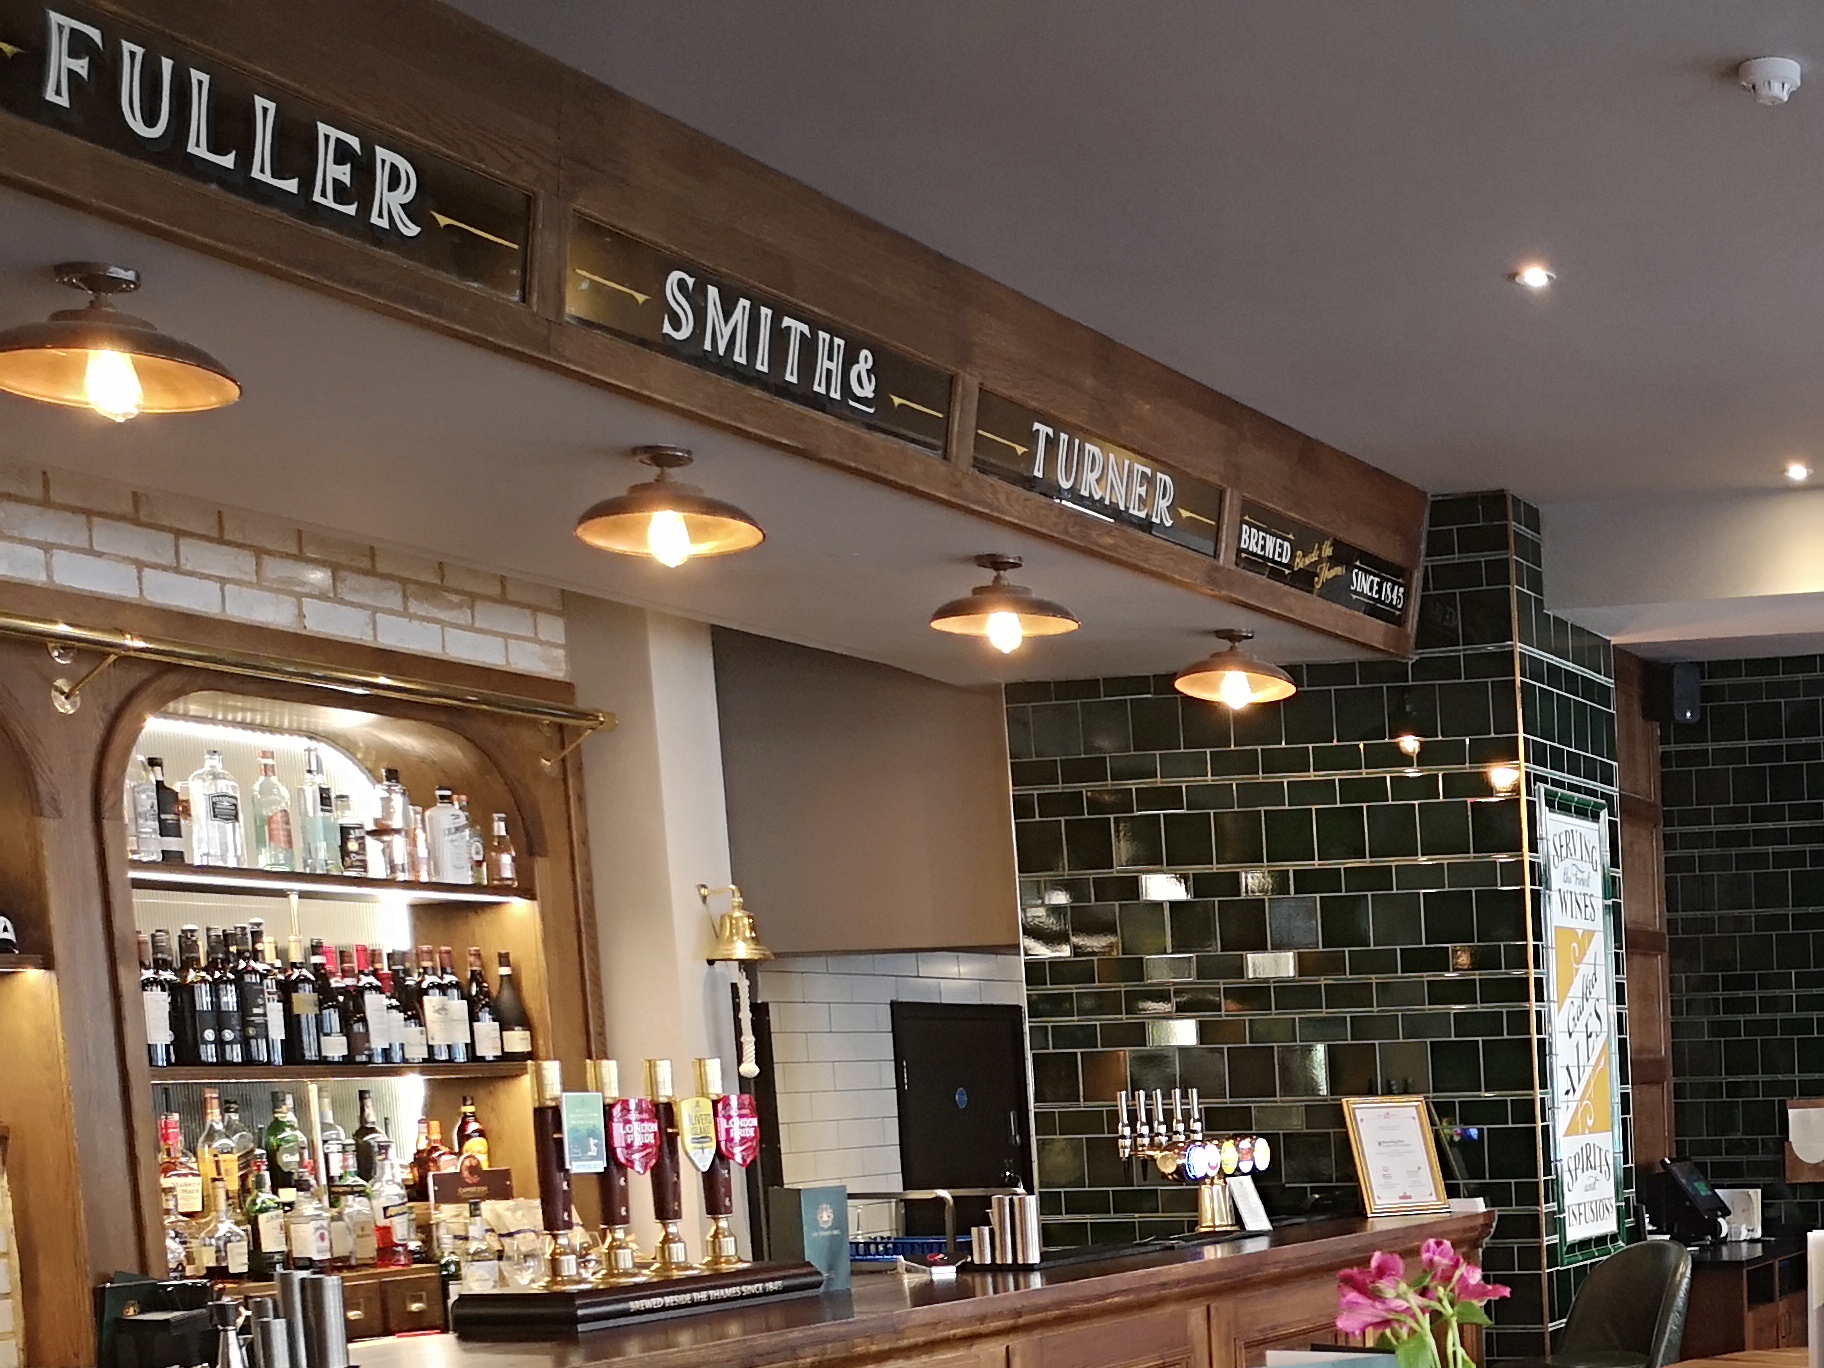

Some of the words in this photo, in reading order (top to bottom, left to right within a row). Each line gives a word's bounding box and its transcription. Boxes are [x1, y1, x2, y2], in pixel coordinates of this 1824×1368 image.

[44, 9, 422, 237] FULLER
[1032, 422, 1174, 527] TURNER
[1240, 524, 1292, 564] BREWED
[1321, 540, 1334, 558] the
[1350, 569, 1381, 599] SINCE
[1381, 580, 1405, 609] 1845
[1552, 829, 1598, 872] SERVING
[1557, 888, 1596, 922] WINES
[1564, 998, 1603, 1113] ALES
[620, 1120, 658, 1134] LONDON
[627, 1132, 655, 1146] PRIDE
[723, 1117, 758, 1128] LONDON
[730, 1127, 755, 1138] PRIDE
[1567, 1142, 1611, 1192] SPIRITS
[1567, 1196, 1614, 1228] INFUSIONS
[629, 1297, 664, 1313] BREWED
[665, 1293, 692, 1308] BESIDE
[692, 1291, 709, 1303] THE
[708, 1286, 741, 1301] THAMES
[742, 1282, 764, 1296] SINCE
[764, 1280, 783, 1292] 1845
